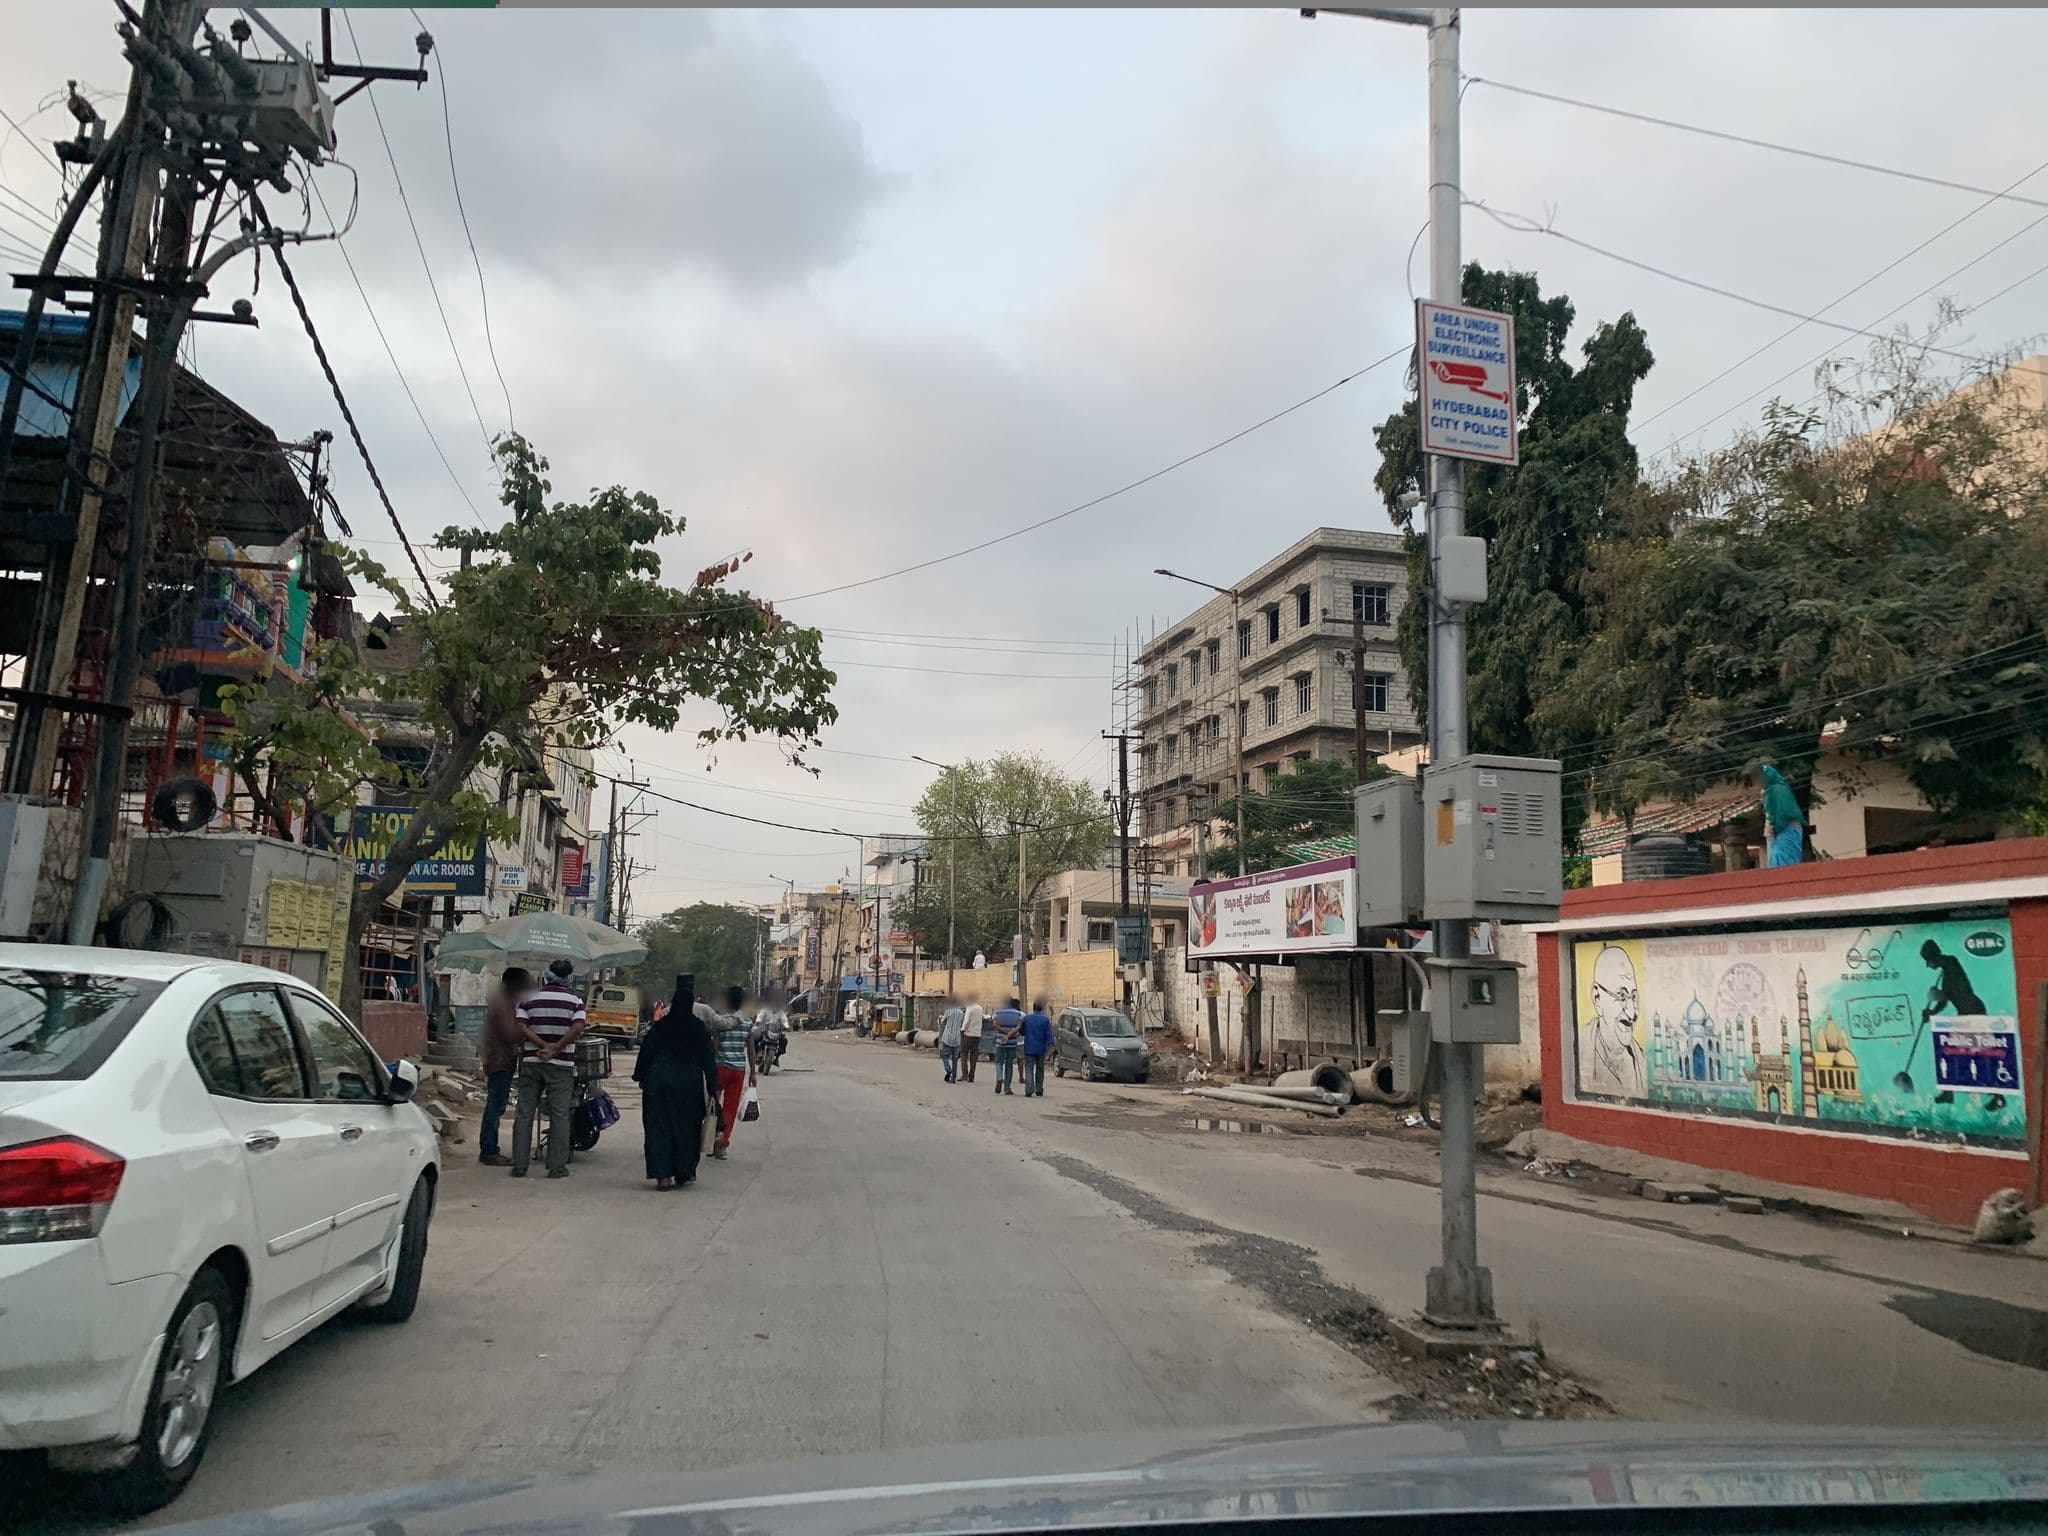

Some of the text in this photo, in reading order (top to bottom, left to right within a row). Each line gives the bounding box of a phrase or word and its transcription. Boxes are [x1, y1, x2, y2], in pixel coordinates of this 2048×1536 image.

[1432, 312, 1500, 333] AREA UNDER
[1435, 327, 1501, 348] ELECTRONIC
[1427, 340, 1506, 364] SURVEILLANCE
[1432, 398, 1508, 420] HYDERABAD
[1431, 416, 1509, 438] CITY POLICE
[422, 863, 439, 876] A/C
[441, 863, 475, 876] ROOMS
[521, 895, 546, 906] HOTEL
[1967, 938, 2004, 949] GHMC
[1939, 1034, 2009, 1048] Public Toilet
